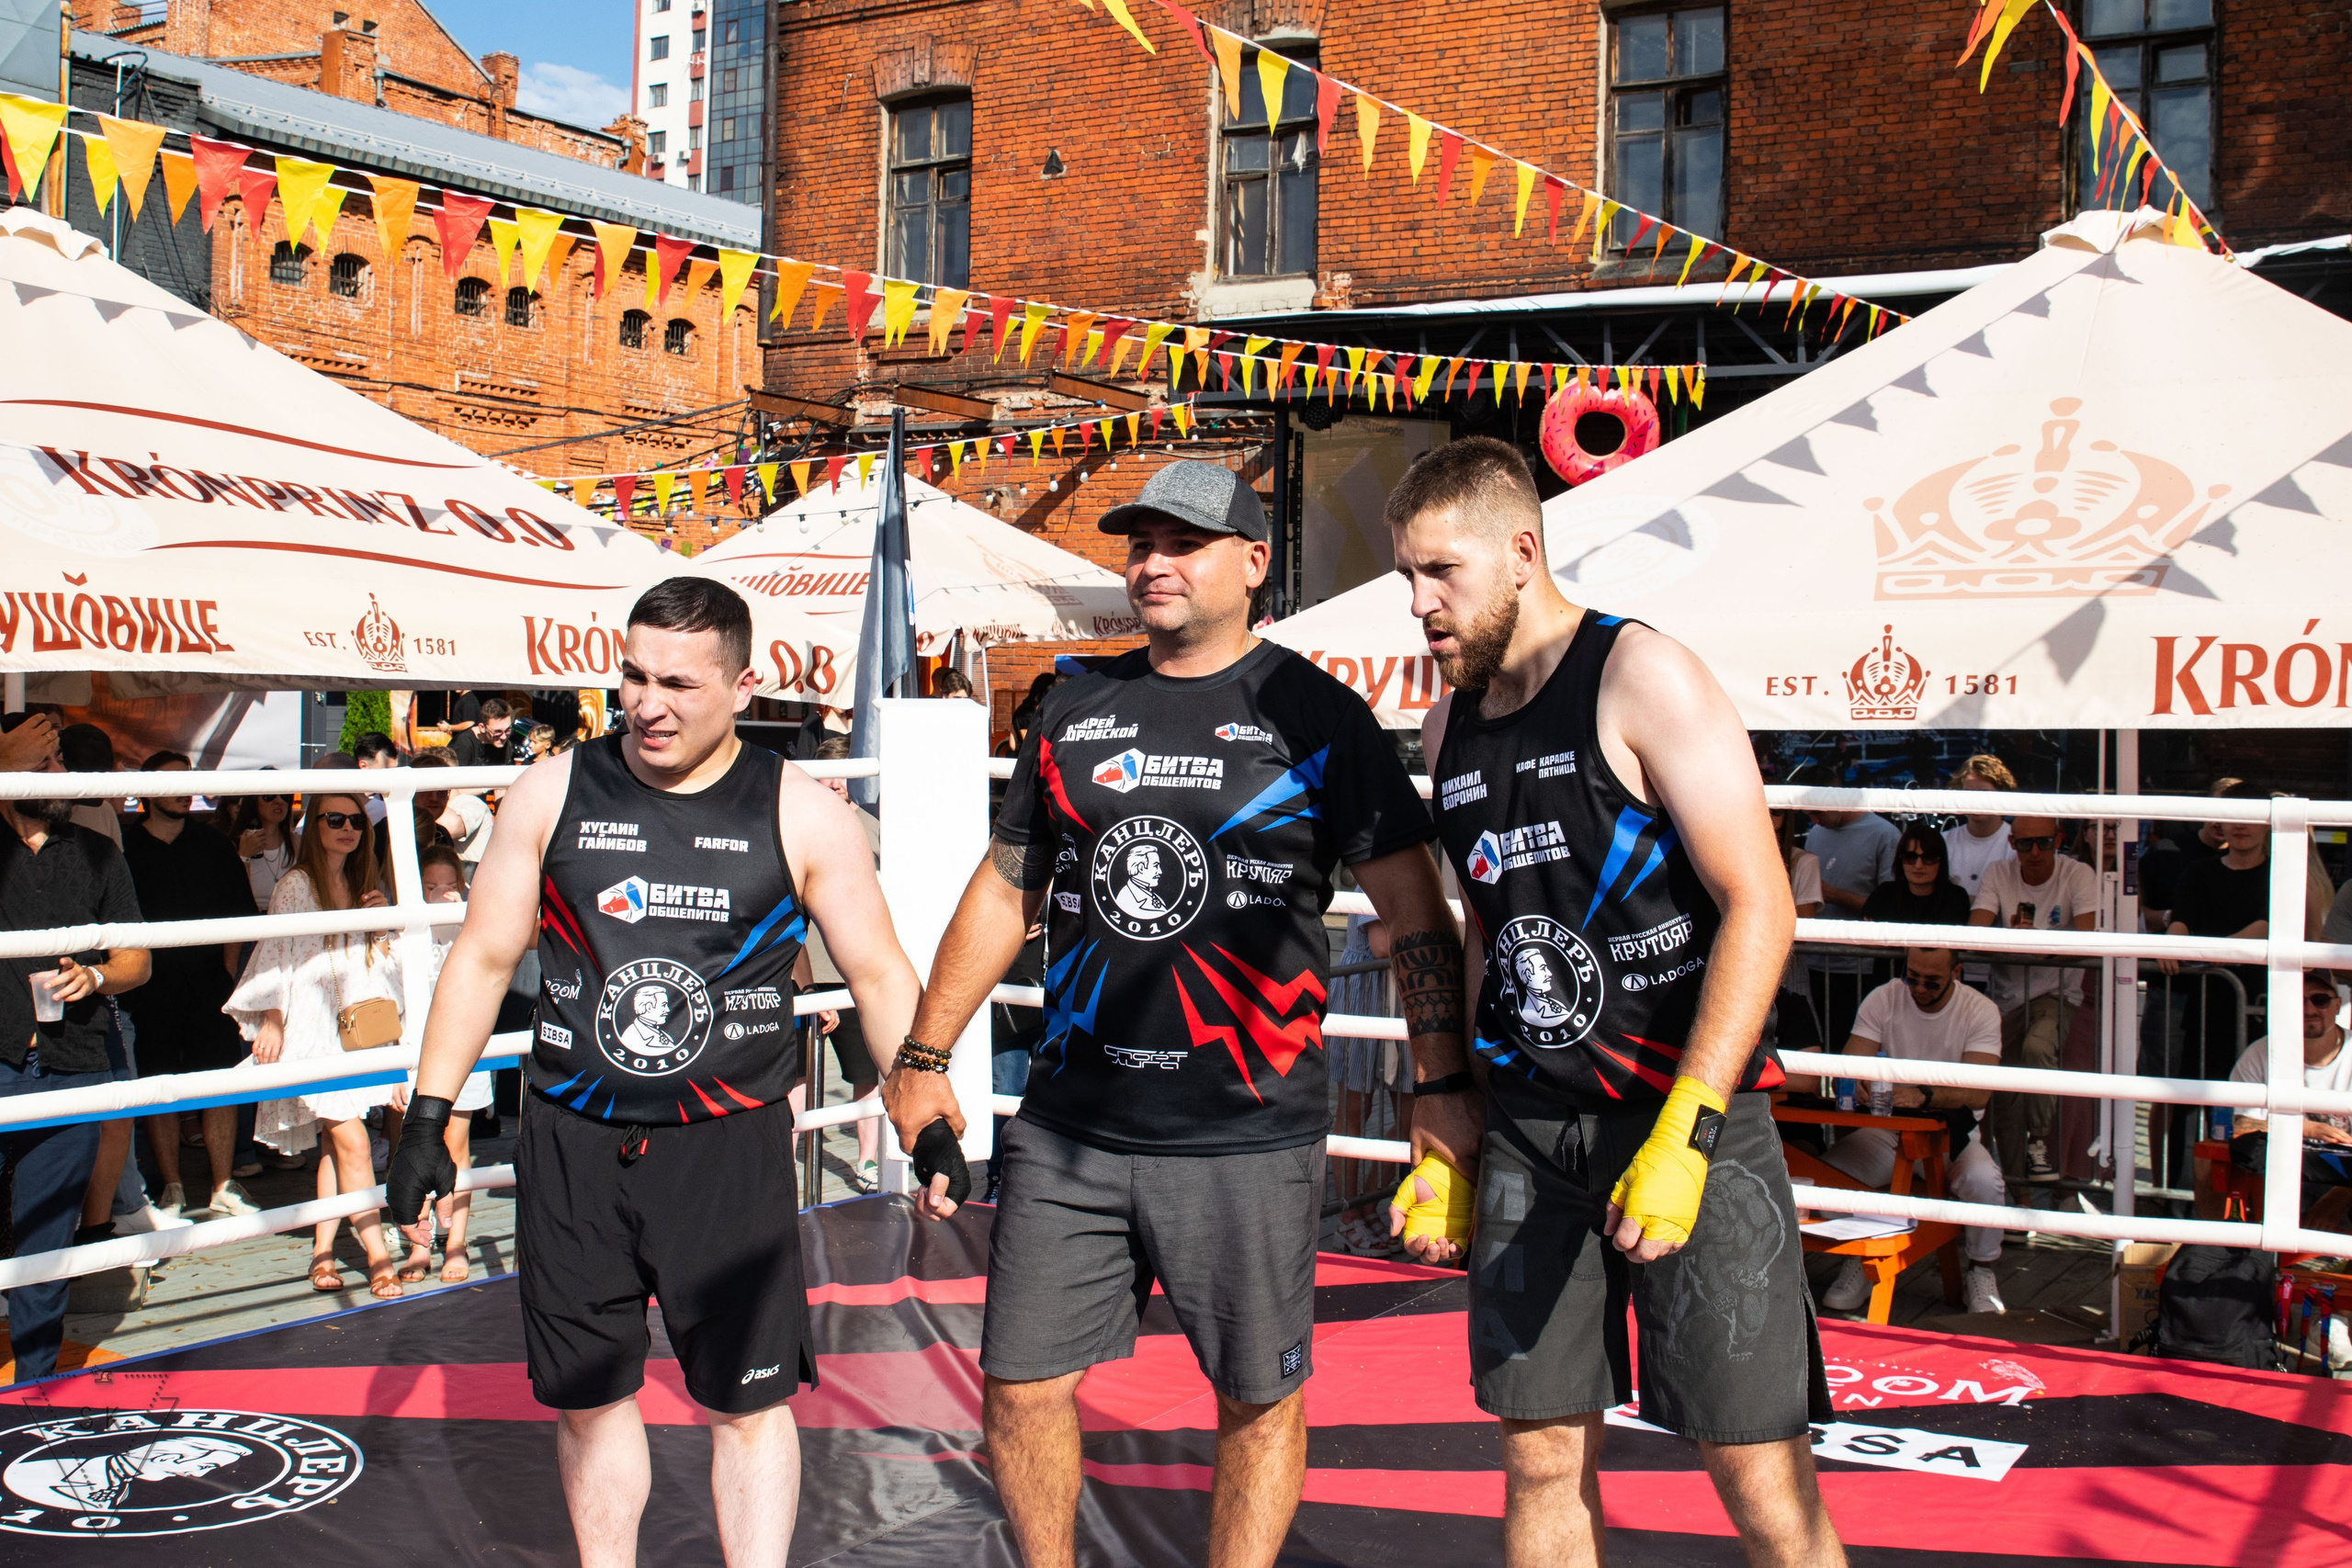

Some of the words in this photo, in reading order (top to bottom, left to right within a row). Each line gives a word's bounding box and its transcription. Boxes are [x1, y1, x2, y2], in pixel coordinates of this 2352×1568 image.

[303, 631, 347, 650] EST.
[413, 637, 457, 657] 1581
[1765, 676, 1830, 697] EST.
[1944, 674, 2018, 696] 1581
[1144, 755, 1224, 778] БИТВА
[1516, 759, 1536, 773] КАФЕ
[1540, 750, 1576, 767] КАРАОКЕ
[1539, 762, 1577, 779] ПЯТНИЦА
[1142, 775, 1222, 790] ОБЩЕПИТОВ
[1442, 770, 1481, 796] МИХАИЛ
[1442, 784, 1487, 811] ВОРОНИН
[580, 821, 639, 836] ХУСАИН
[1499, 820, 1566, 856] БИТВА
[578, 833, 647, 852] ГАЙИБОВ
[695, 836, 749, 852] FARFOR
[1094, 820, 1204, 887] КАНЦЛЕРЪ
[1503, 845, 1571, 872] ОБЩЕПИТОВ
[649, 883, 730, 909] БИТВА
[649, 905, 729, 922] ОБЩЕПИТОВ
[1109, 910, 1182, 934] 2010
[1610, 920, 1693, 962] КРУТОЯР
[1650, 956, 1705, 985] LADOGA
[600, 963, 707, 1023] КАНЦЛЕРЪ
[725, 992, 782, 1011] КРУТОЯР
[542, 1025, 571, 1046] SIBSA
[747, 1021, 780, 1035] LADOGA
[613, 1048, 690, 1070] 2010
